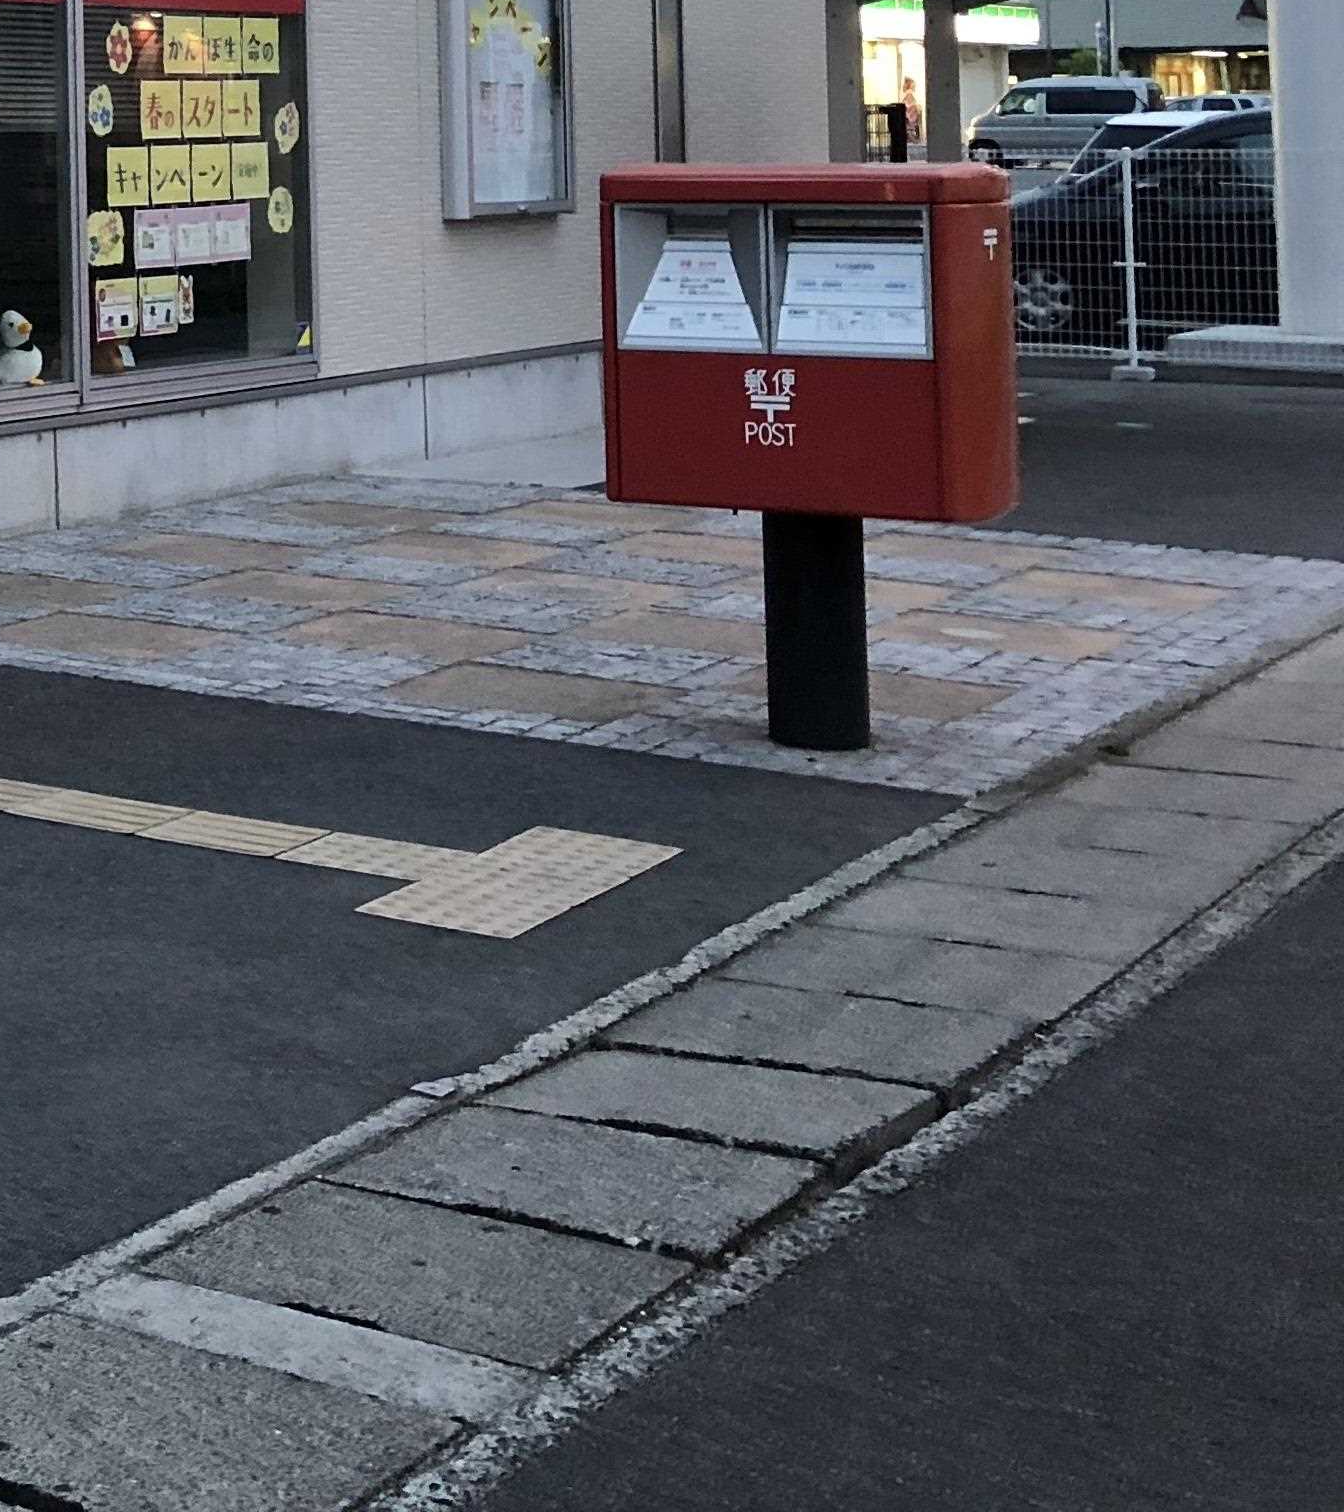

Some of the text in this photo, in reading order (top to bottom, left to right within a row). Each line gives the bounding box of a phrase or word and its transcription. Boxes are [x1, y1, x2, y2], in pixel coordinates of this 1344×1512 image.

[145, 91, 253, 130] 春のスタート
[744, 368, 797, 397] 郵便
[744, 421, 797, 448] POST
